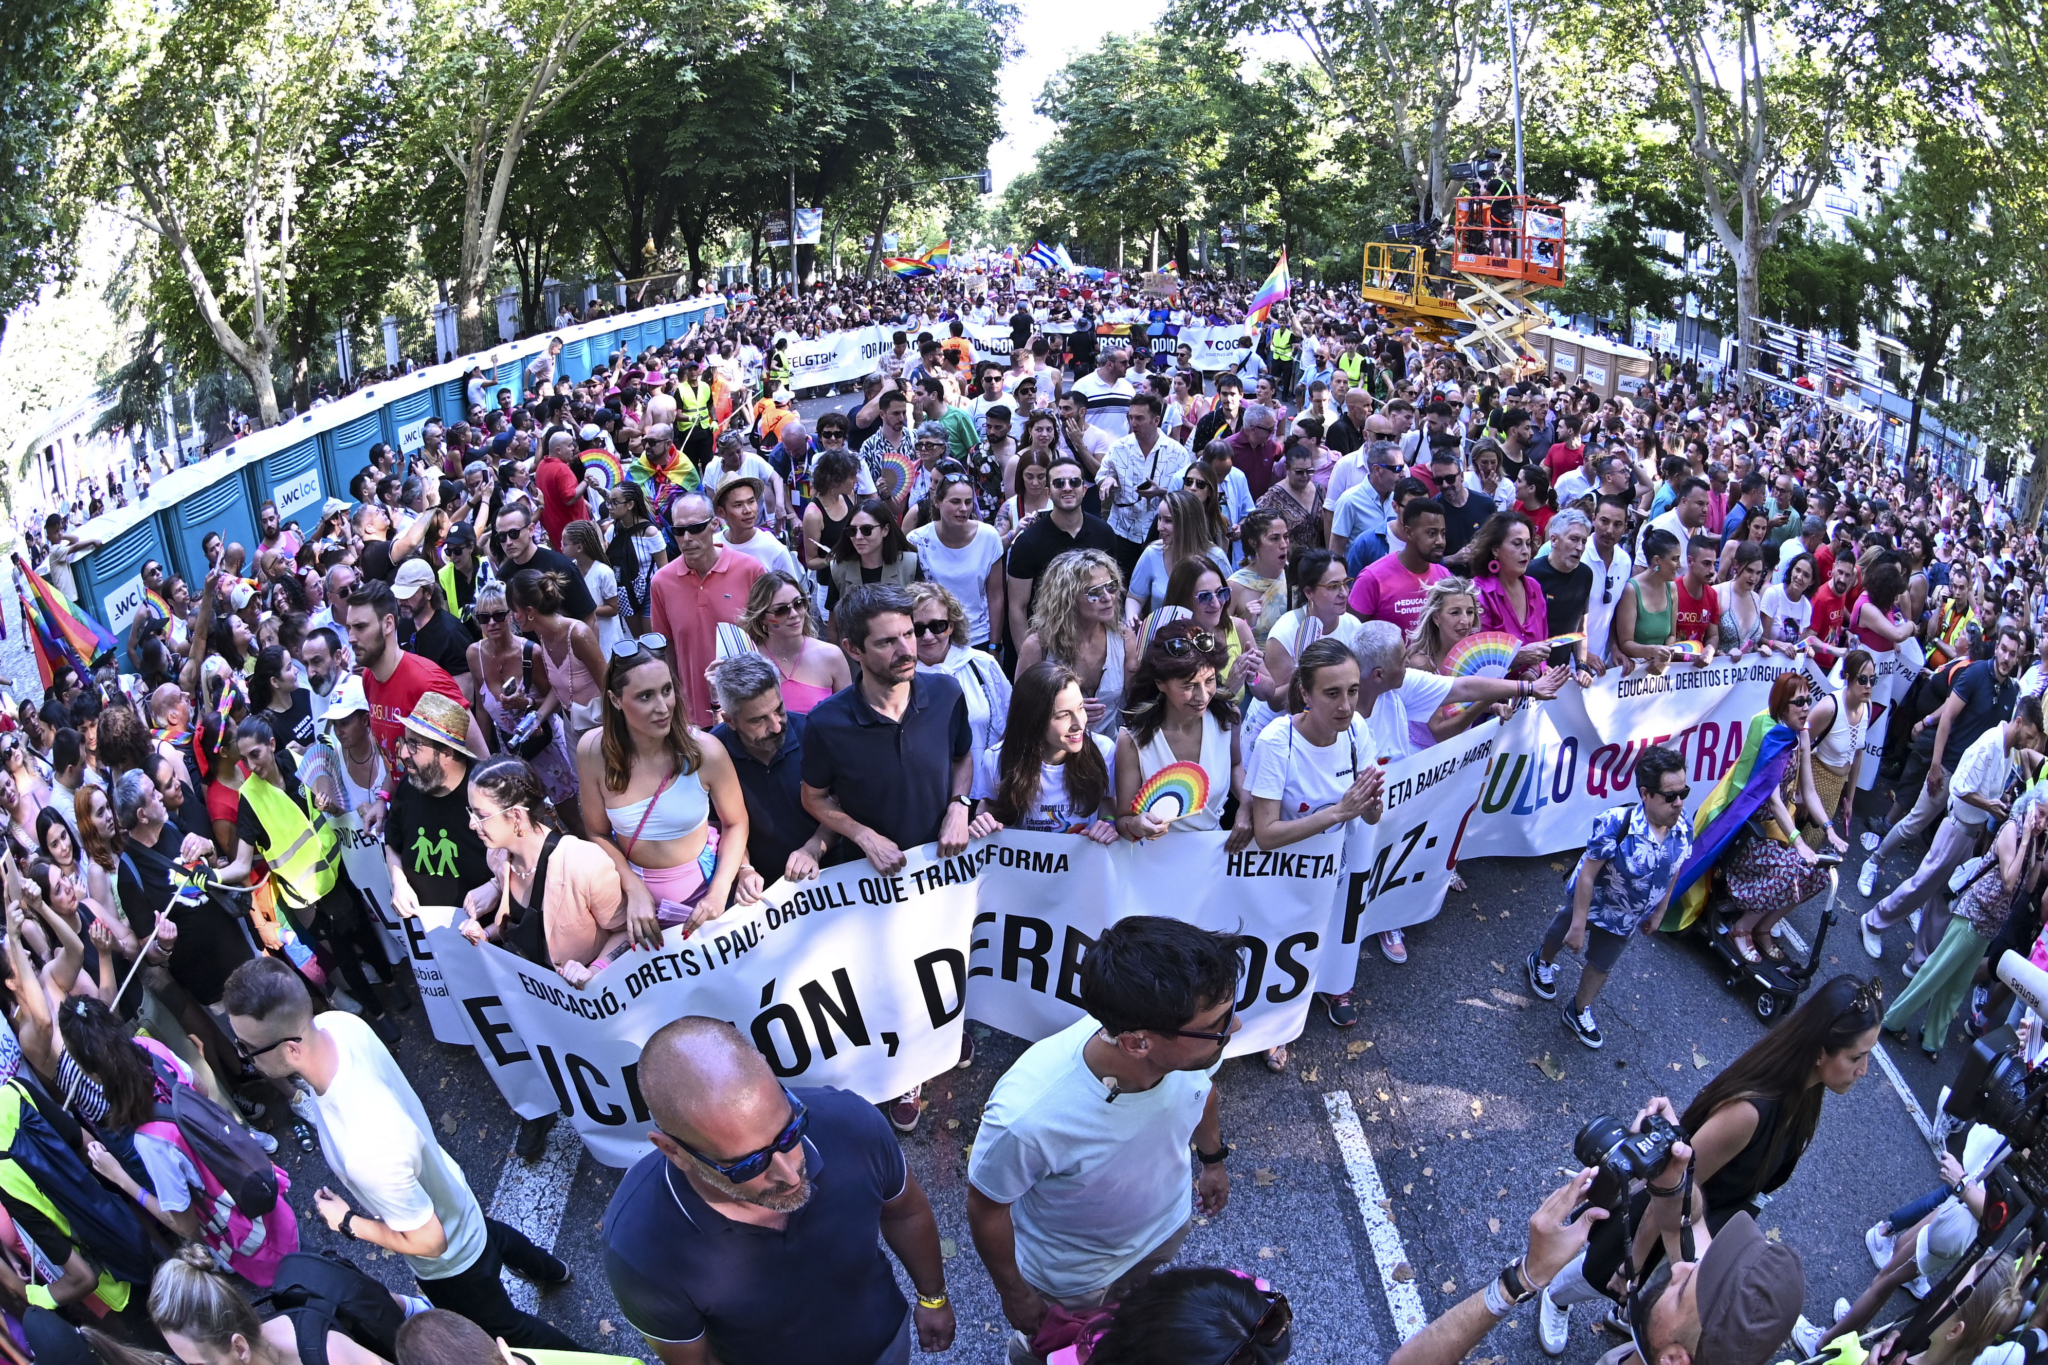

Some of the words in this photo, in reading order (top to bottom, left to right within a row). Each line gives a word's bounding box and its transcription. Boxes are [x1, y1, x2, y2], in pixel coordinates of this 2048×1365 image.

[861, 342, 877, 361] POR
[1151, 337, 1176, 354] ODIO
[1675, 669, 1721, 692] DEREITOS
[1723, 668, 1730, 686] E
[1387, 777, 1413, 810] ETA
[1414, 757, 1460, 796] BAKEA:
[1458, 738, 1494, 771] HARR
[351, 828, 380, 850] PEA
[1226, 849, 1338, 880] HEZIKETA,
[517, 970, 627, 1020] EDUCACIÓ,
[624, 949, 701, 999] DRETS
[700, 943, 715, 971] I
[713, 921, 765, 966] PAU:
[765, 881, 856, 931] ORGULL
[857, 876, 909, 907] QUE
[910, 843, 1070, 895] TRANSFORMA
[2010, 977, 2040, 1008] REUTERS
